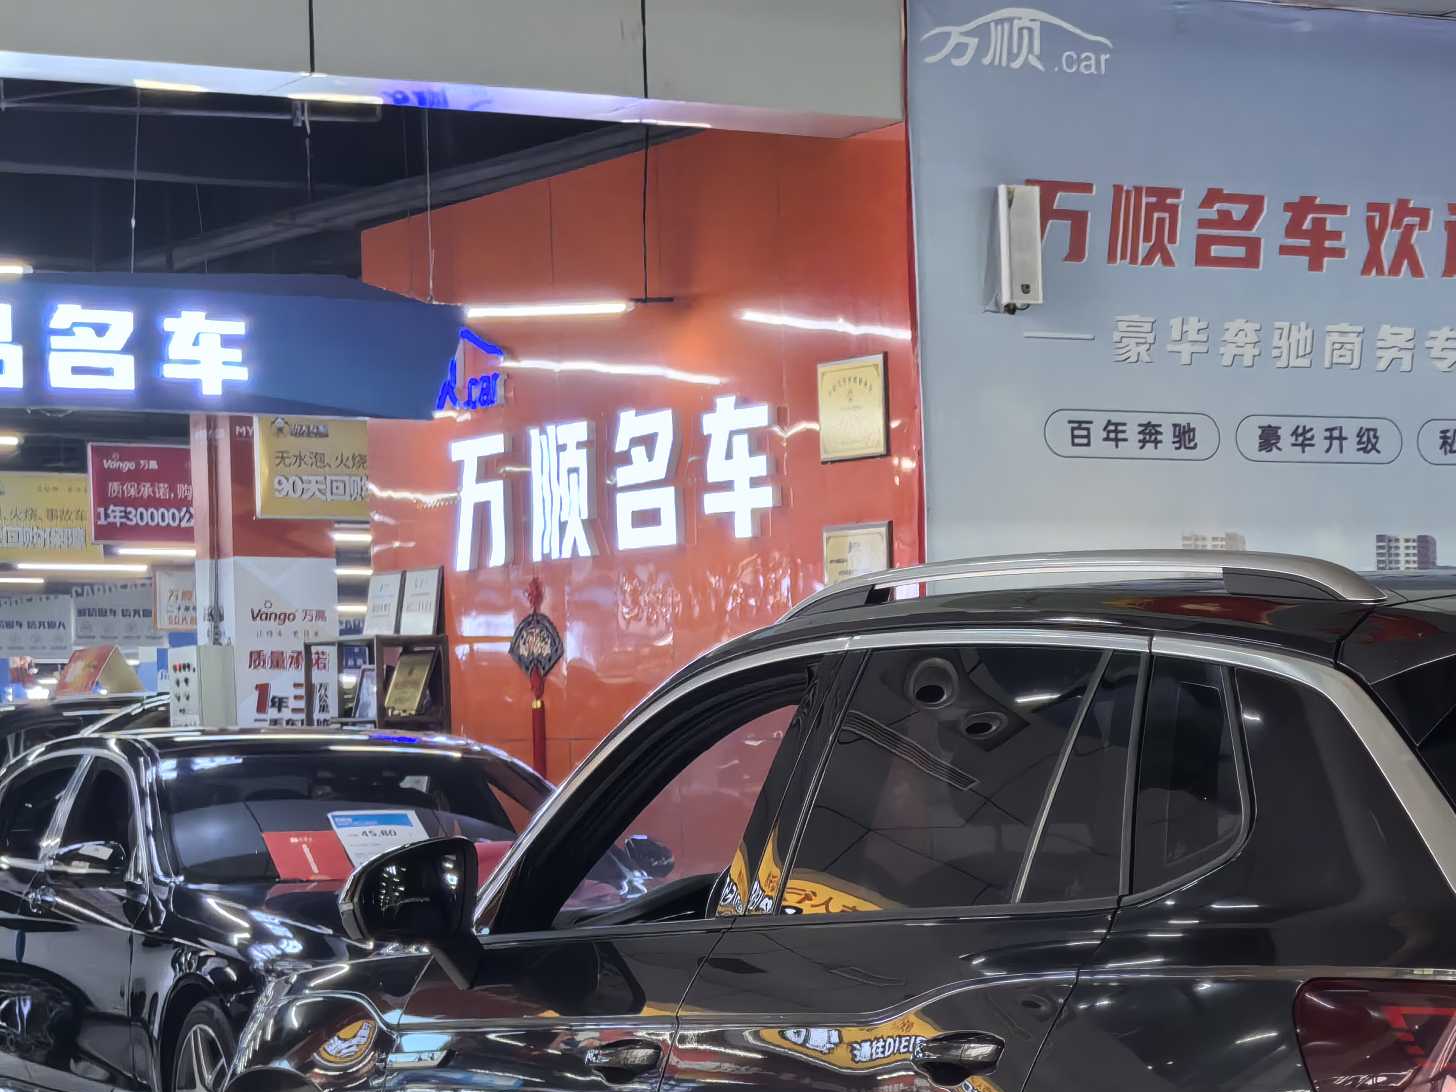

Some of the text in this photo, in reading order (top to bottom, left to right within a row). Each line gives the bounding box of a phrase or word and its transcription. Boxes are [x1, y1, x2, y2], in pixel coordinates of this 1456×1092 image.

[1067, 419, 1198, 452] 百年奔驰
[1257, 424, 1381, 455] 豪华升级
[450, 395, 774, 572] 万顺名车
[250, 608, 297, 625] Vango
